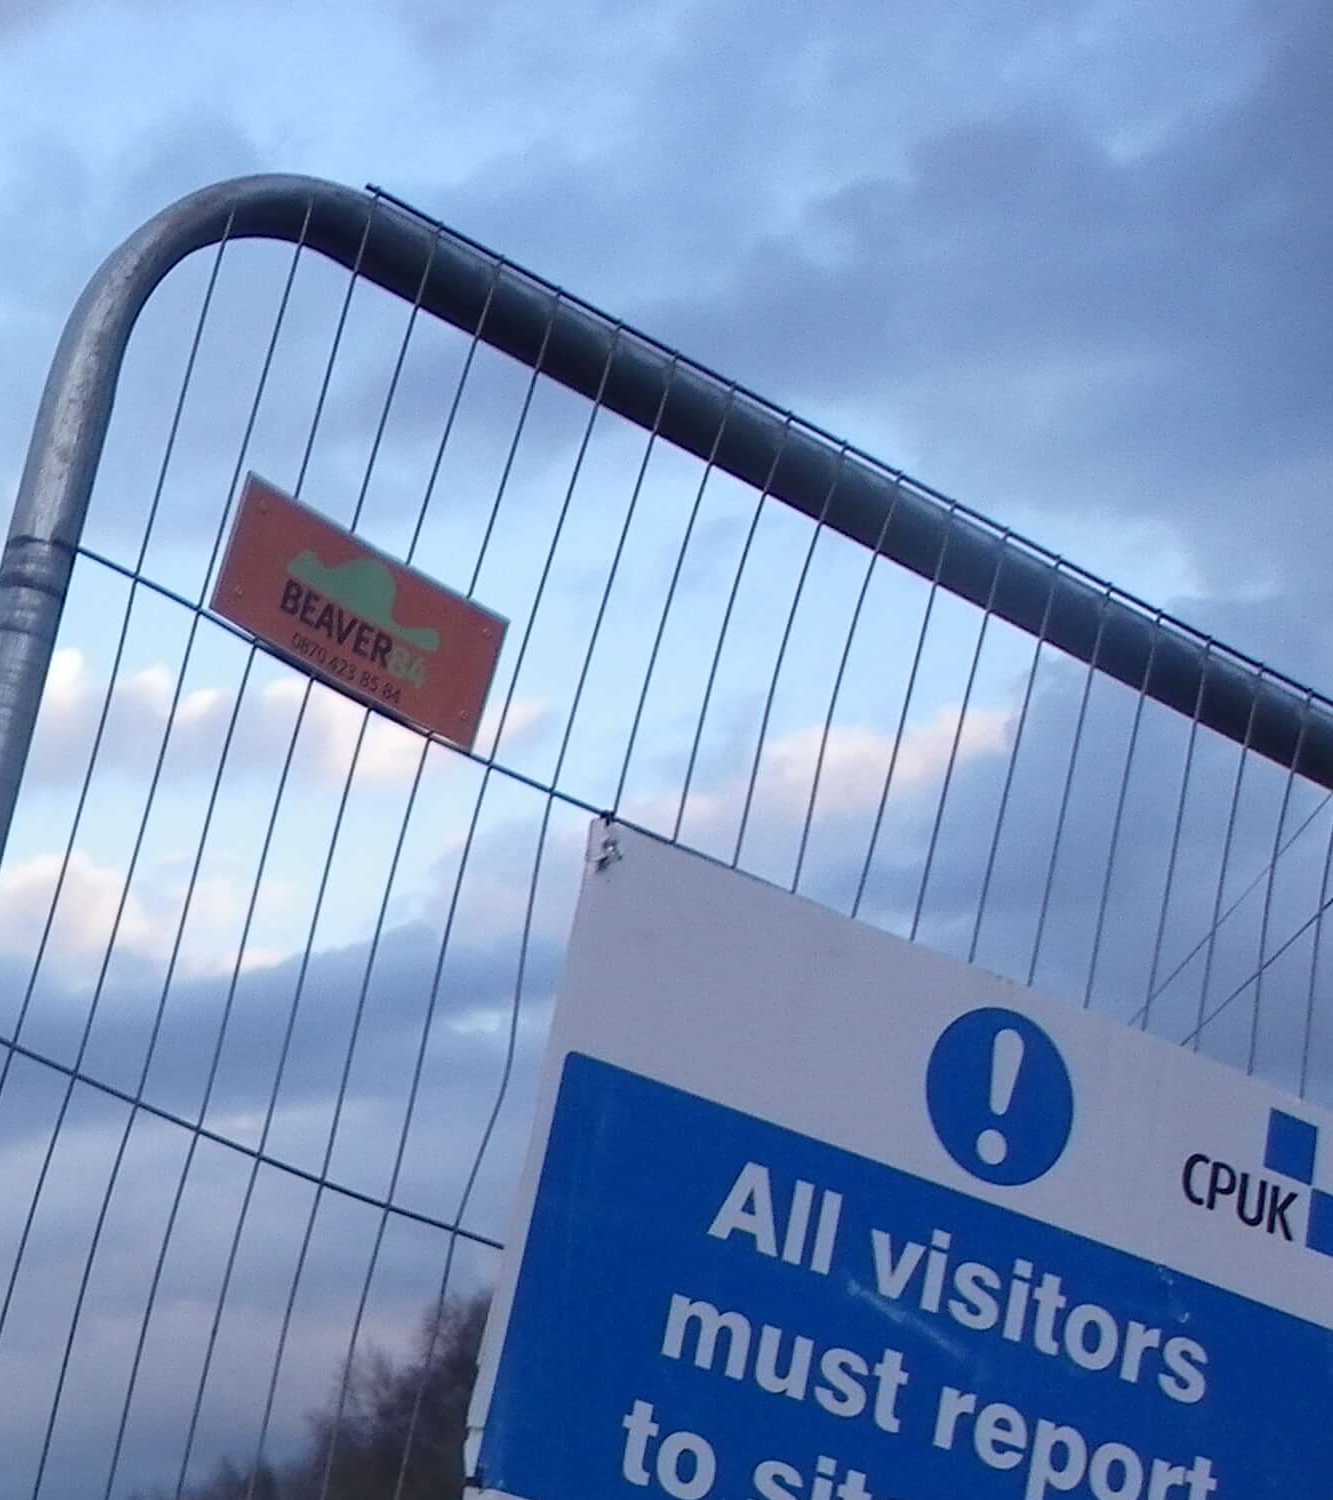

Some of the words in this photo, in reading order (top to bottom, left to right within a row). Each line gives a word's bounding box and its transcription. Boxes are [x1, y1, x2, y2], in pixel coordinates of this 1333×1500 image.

[280, 578, 393, 668] BEAVER
[1182, 1153, 1299, 1242] CPUK
[708, 1162, 843, 1275] All
[871, 1229, 1208, 1404] visitors
[661, 1293, 909, 1434] must
